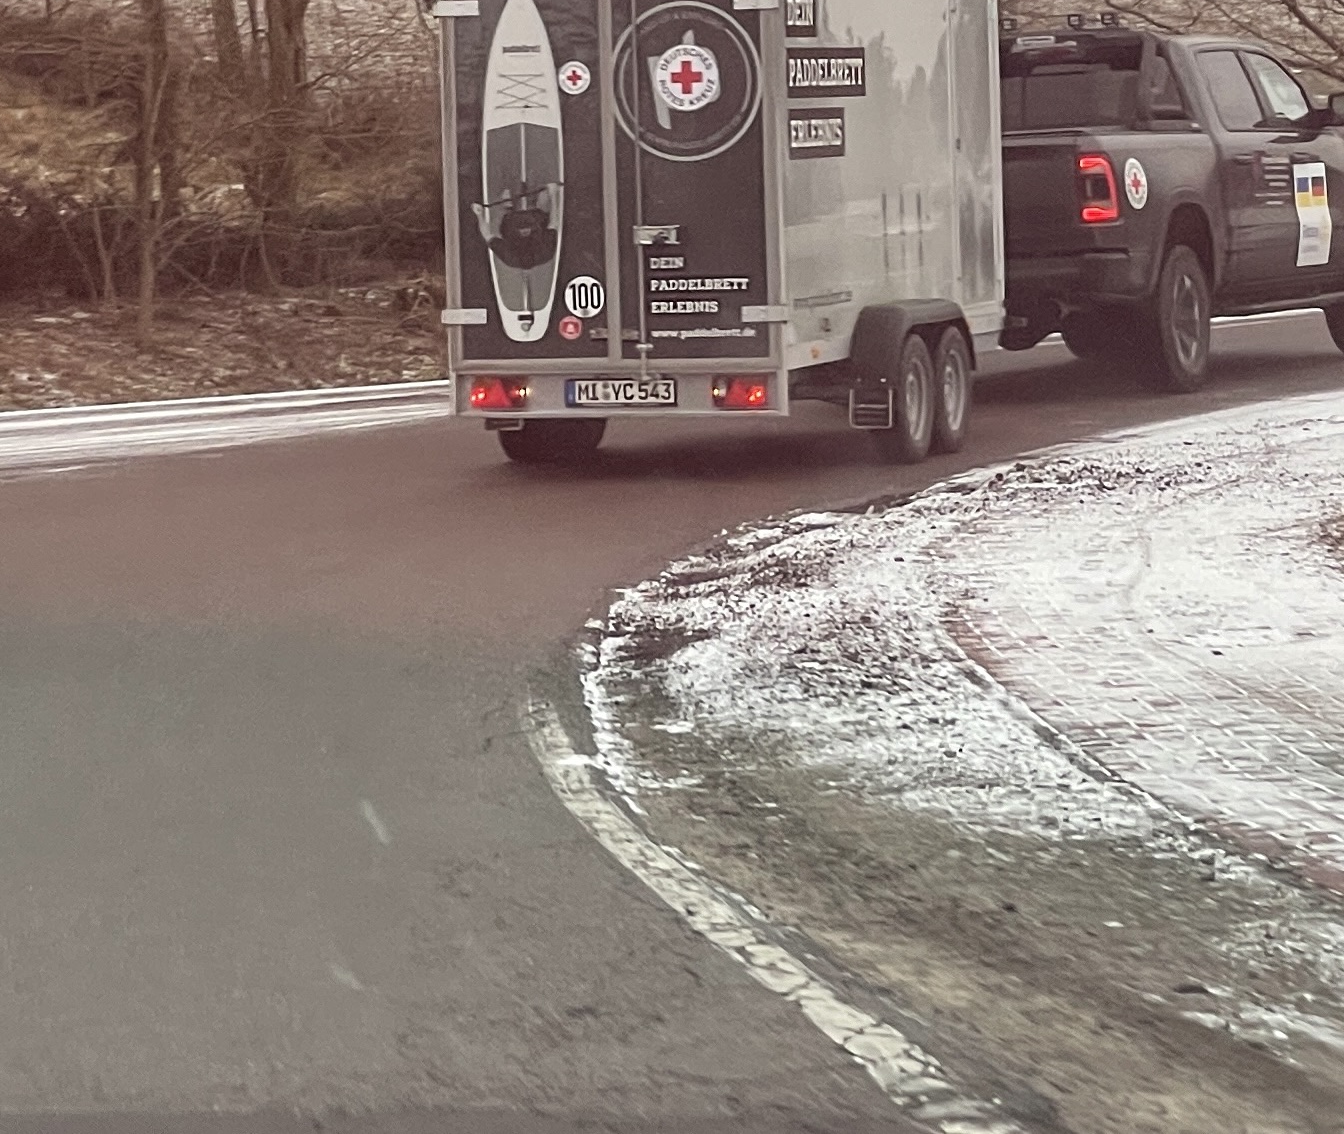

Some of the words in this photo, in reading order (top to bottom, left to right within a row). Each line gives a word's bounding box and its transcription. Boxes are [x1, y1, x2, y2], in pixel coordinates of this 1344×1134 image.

[659, 47, 713, 72] DEUTSCHES
[788, 57, 863, 87] PADDELBRETT
[650, 257, 684, 269] DEIN
[650, 277, 749, 291] PADDELBRETT
[568, 282, 602, 311] 100
[651, 301, 719, 314] ERLEBNIS
[637, 382, 672, 400] 543
